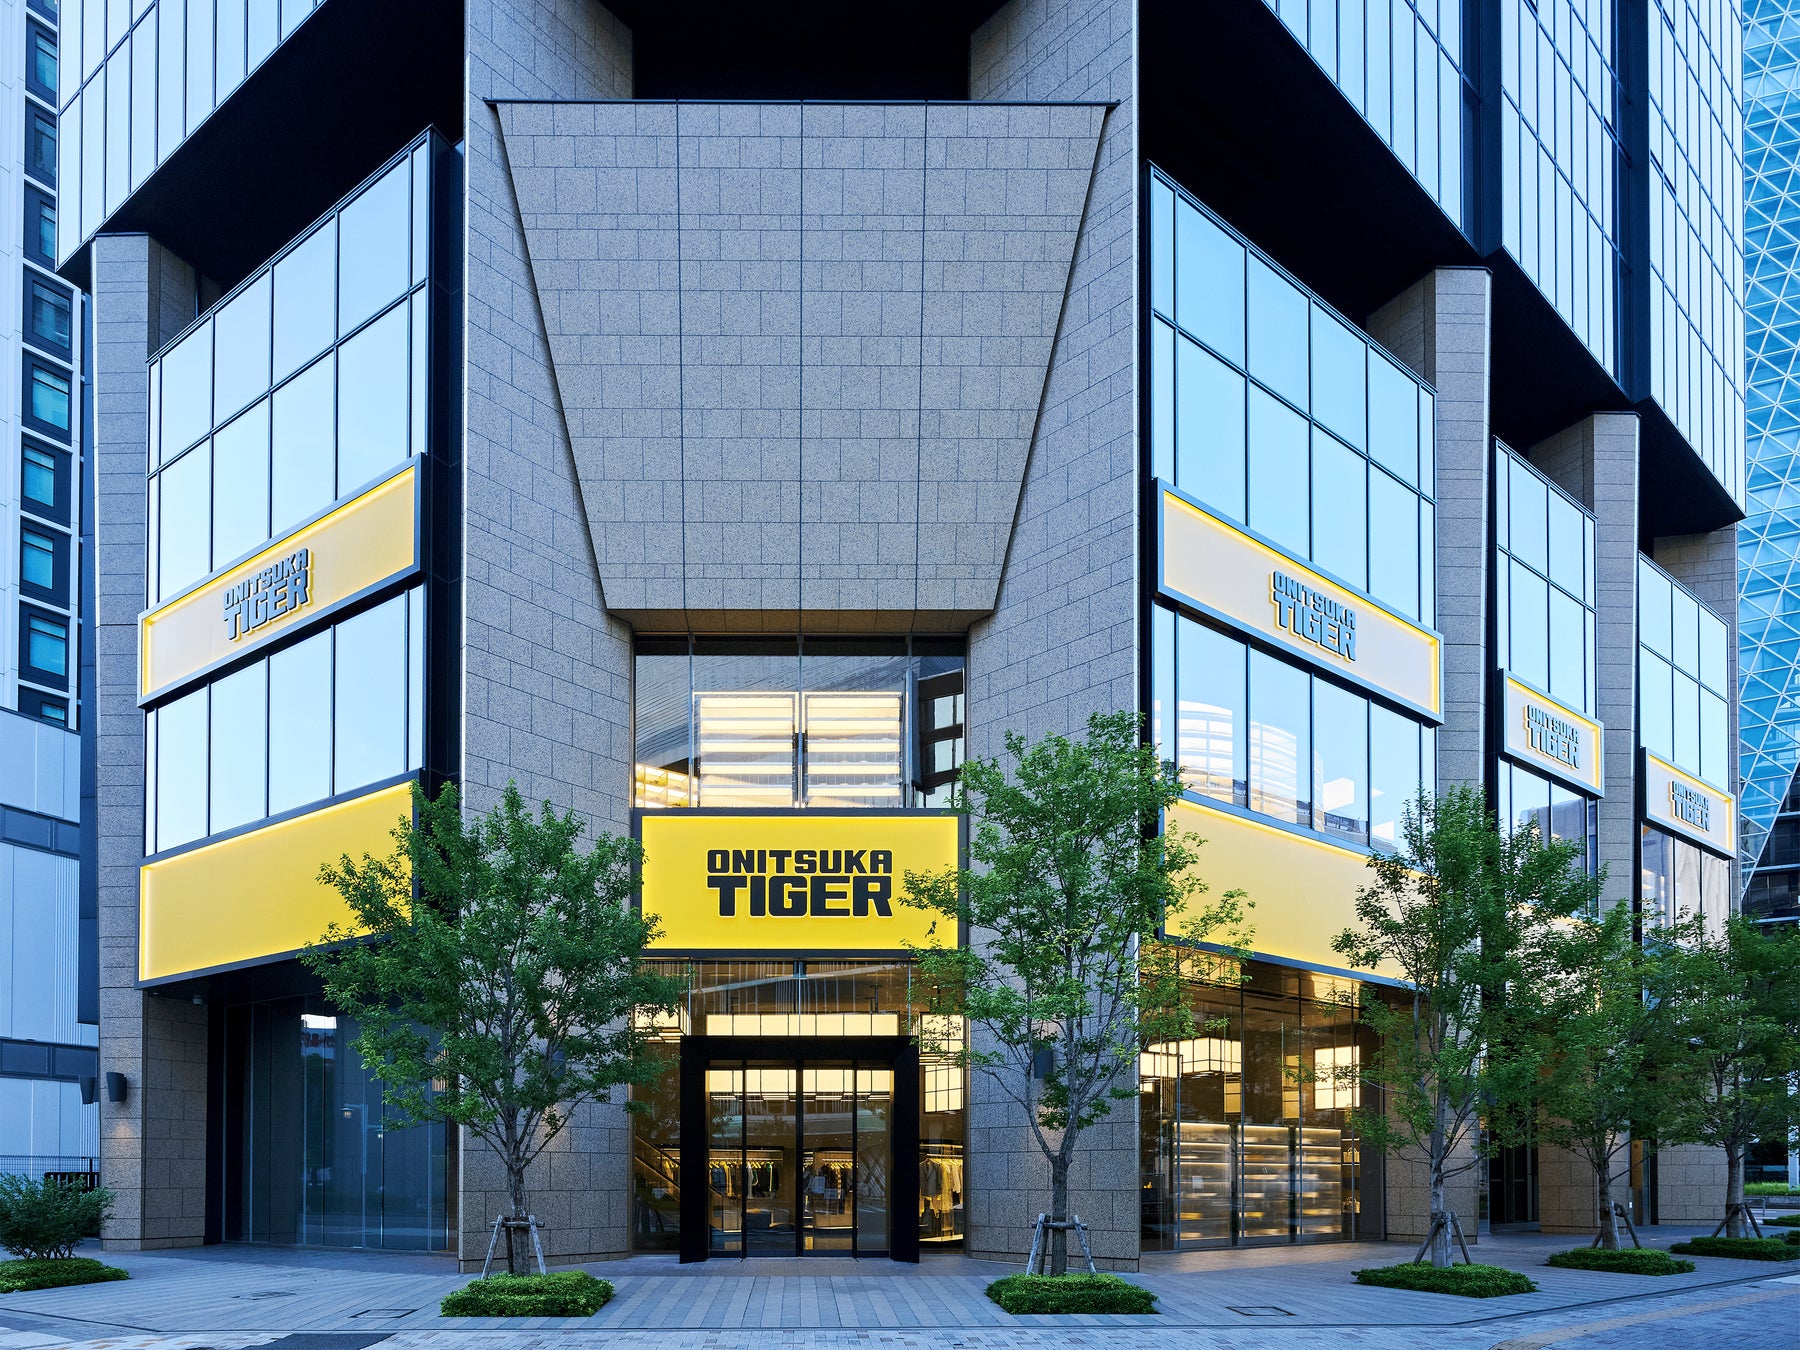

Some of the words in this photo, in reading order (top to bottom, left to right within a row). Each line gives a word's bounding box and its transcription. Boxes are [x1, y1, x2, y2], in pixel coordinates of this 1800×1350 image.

[224, 548, 308, 610] ONITSUKA
[1273, 571, 1356, 630] ONITSUKA
[224, 568, 308, 640] TIGER
[1273, 591, 1356, 662] TIGER
[1527, 704, 1579, 744] ONITSUKA
[1527, 720, 1579, 769] TIGER
[1671, 793, 1710, 831] TIGER
[707, 850, 892, 874] ONITSUKA
[707, 876, 892, 917] TIGER
